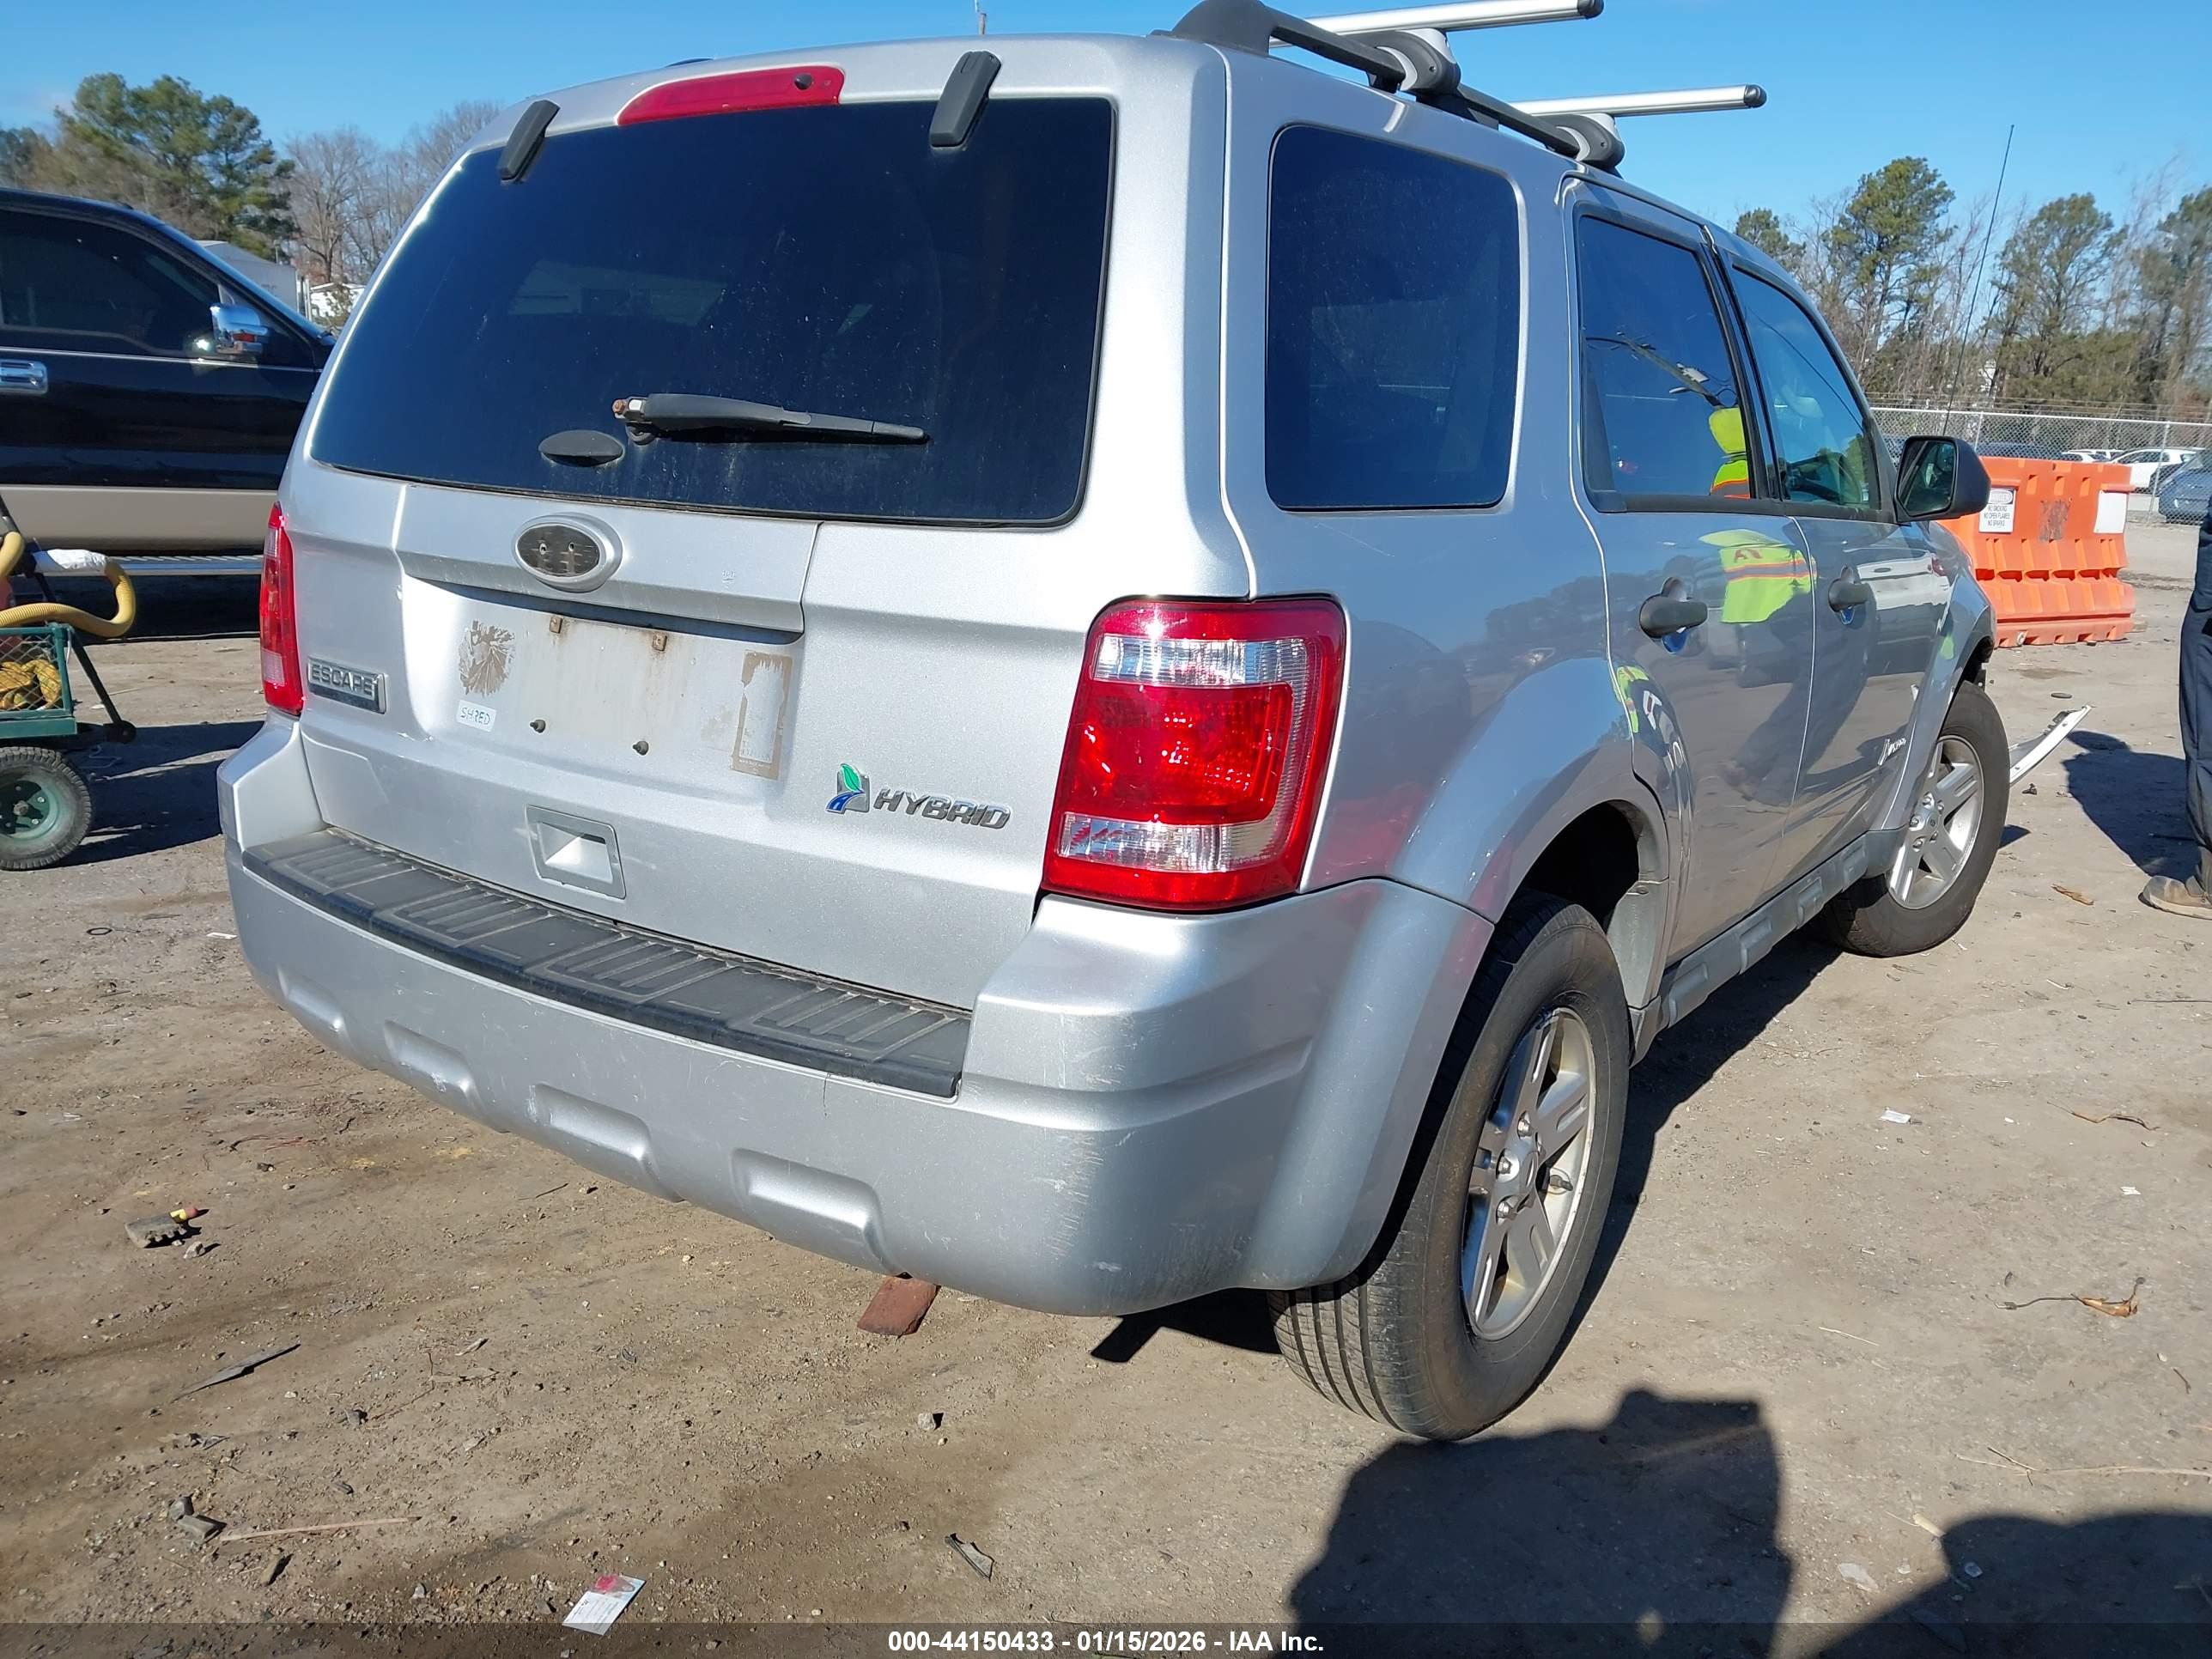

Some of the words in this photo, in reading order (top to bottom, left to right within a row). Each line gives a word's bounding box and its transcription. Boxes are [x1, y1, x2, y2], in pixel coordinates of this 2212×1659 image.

[311, 663, 375, 699] ESCAPE
[460, 706, 491, 726] SHRED
[872, 787, 1012, 830] HYBRID
